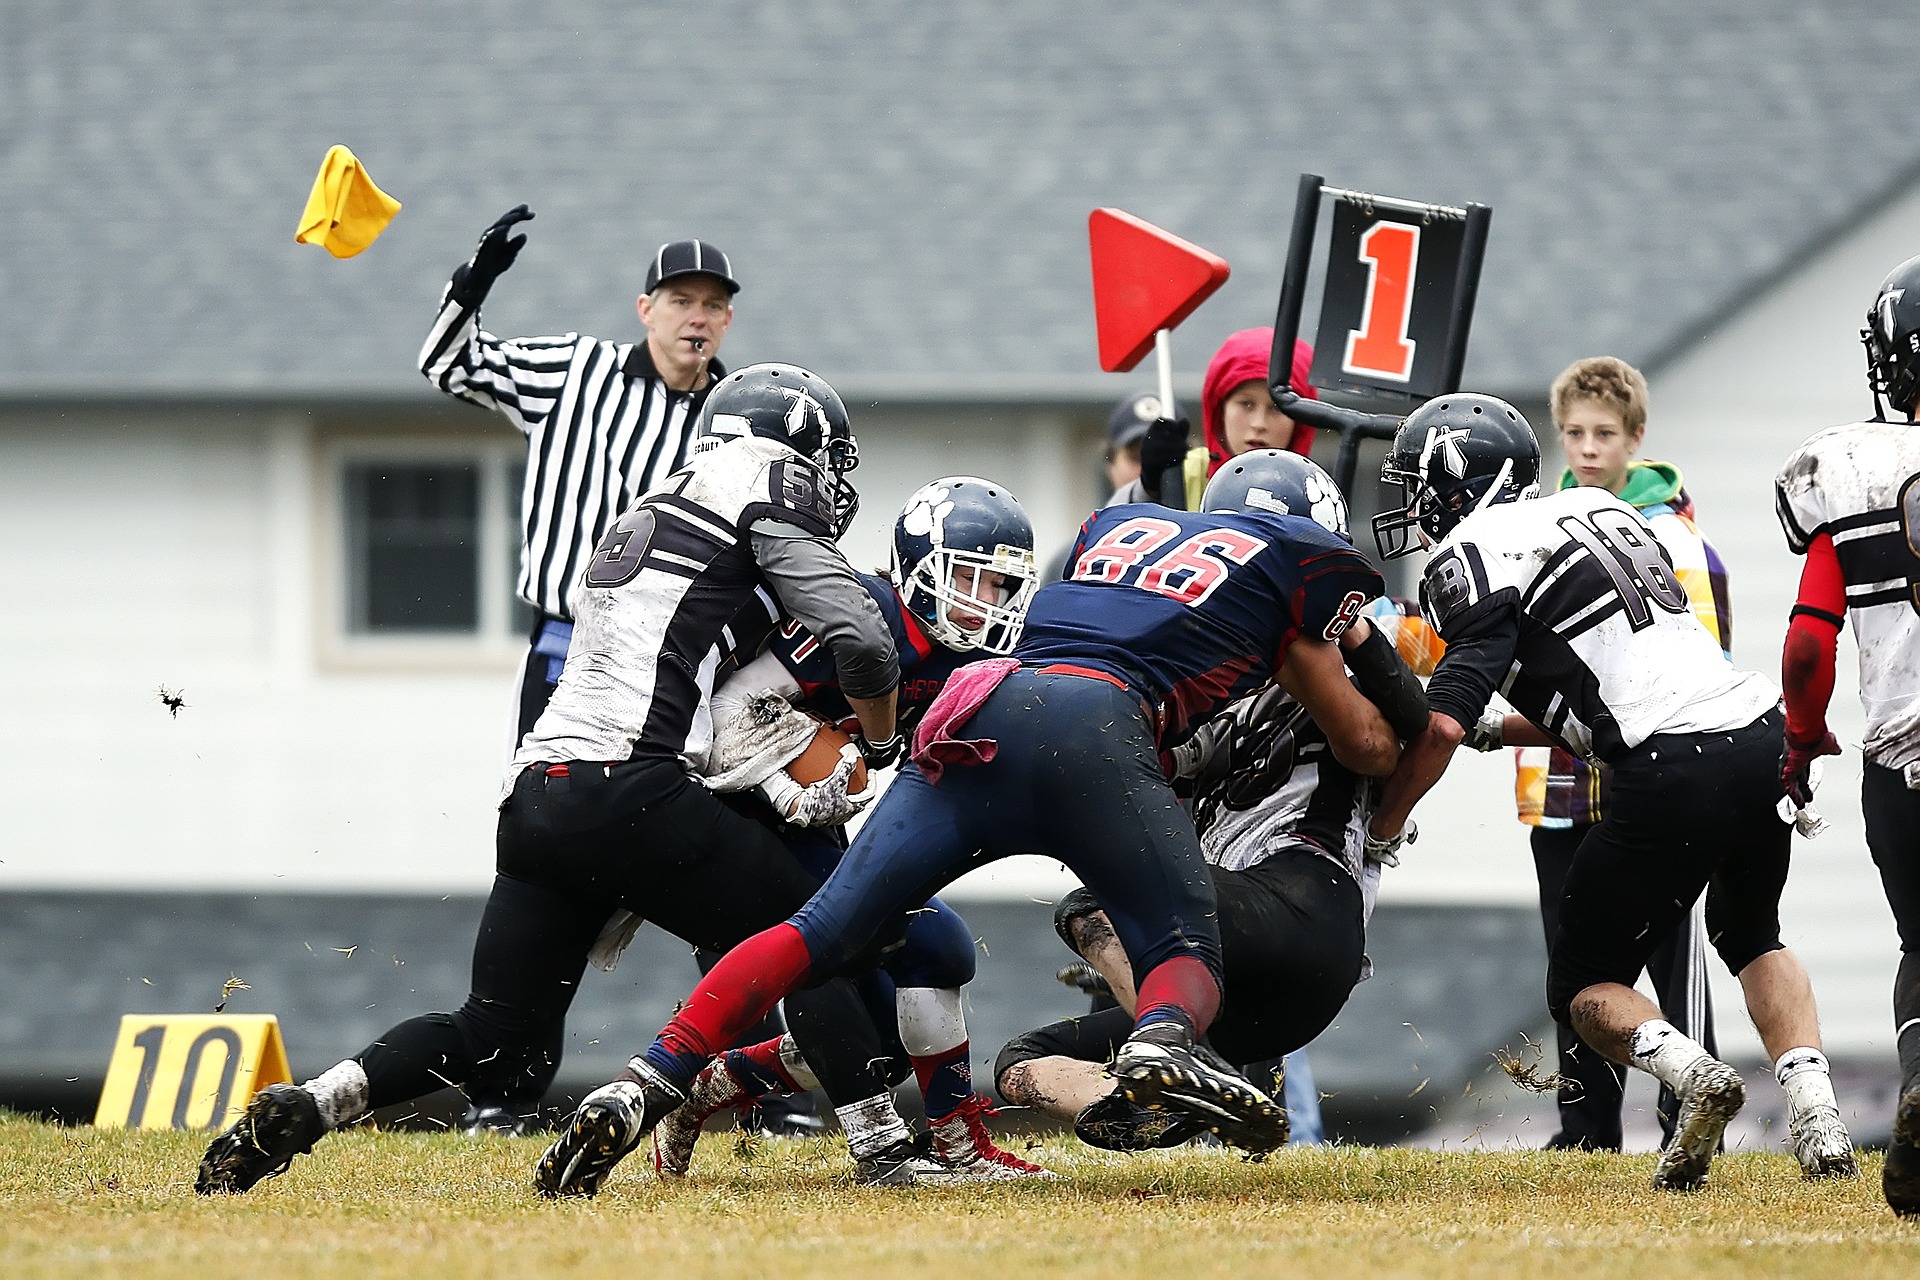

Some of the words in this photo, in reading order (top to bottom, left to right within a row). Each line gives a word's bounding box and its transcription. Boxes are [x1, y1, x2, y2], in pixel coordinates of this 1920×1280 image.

[1342, 219, 1421, 384] 1
[1069, 517, 1269, 608] 86
[1556, 508, 1691, 634] 18
[124, 1024, 243, 1132] 10
